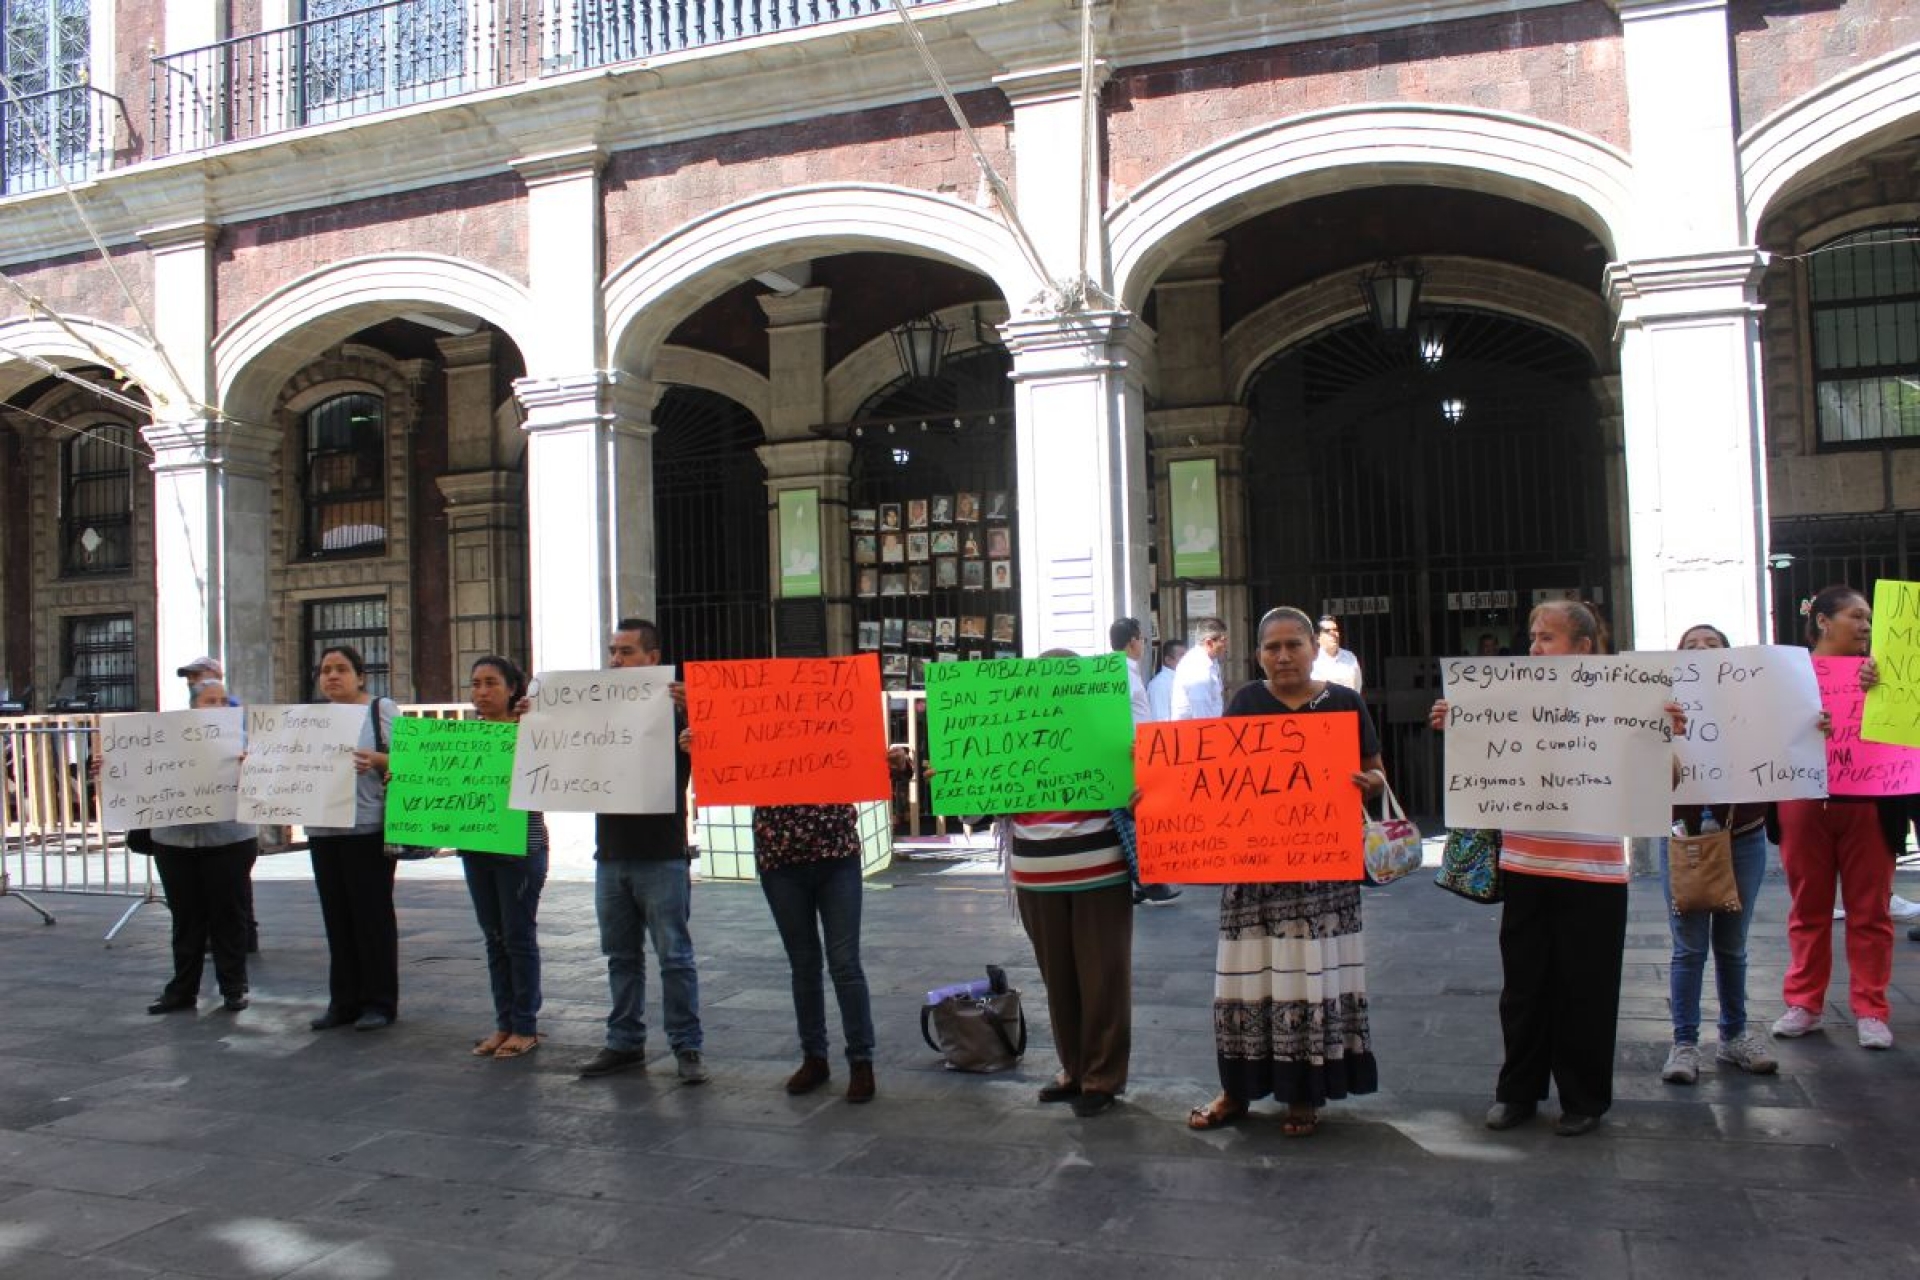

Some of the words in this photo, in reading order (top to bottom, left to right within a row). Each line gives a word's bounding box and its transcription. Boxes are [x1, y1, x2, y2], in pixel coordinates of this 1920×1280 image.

[791, 658, 862, 687] ESTA
[926, 665, 961, 684] LOS
[976, 658, 1082, 681] POBLADOS
[1091, 654, 1121, 674] DE
[1146, 719, 1306, 767] ALEXIS
[1189, 760, 1314, 803] AYALA
